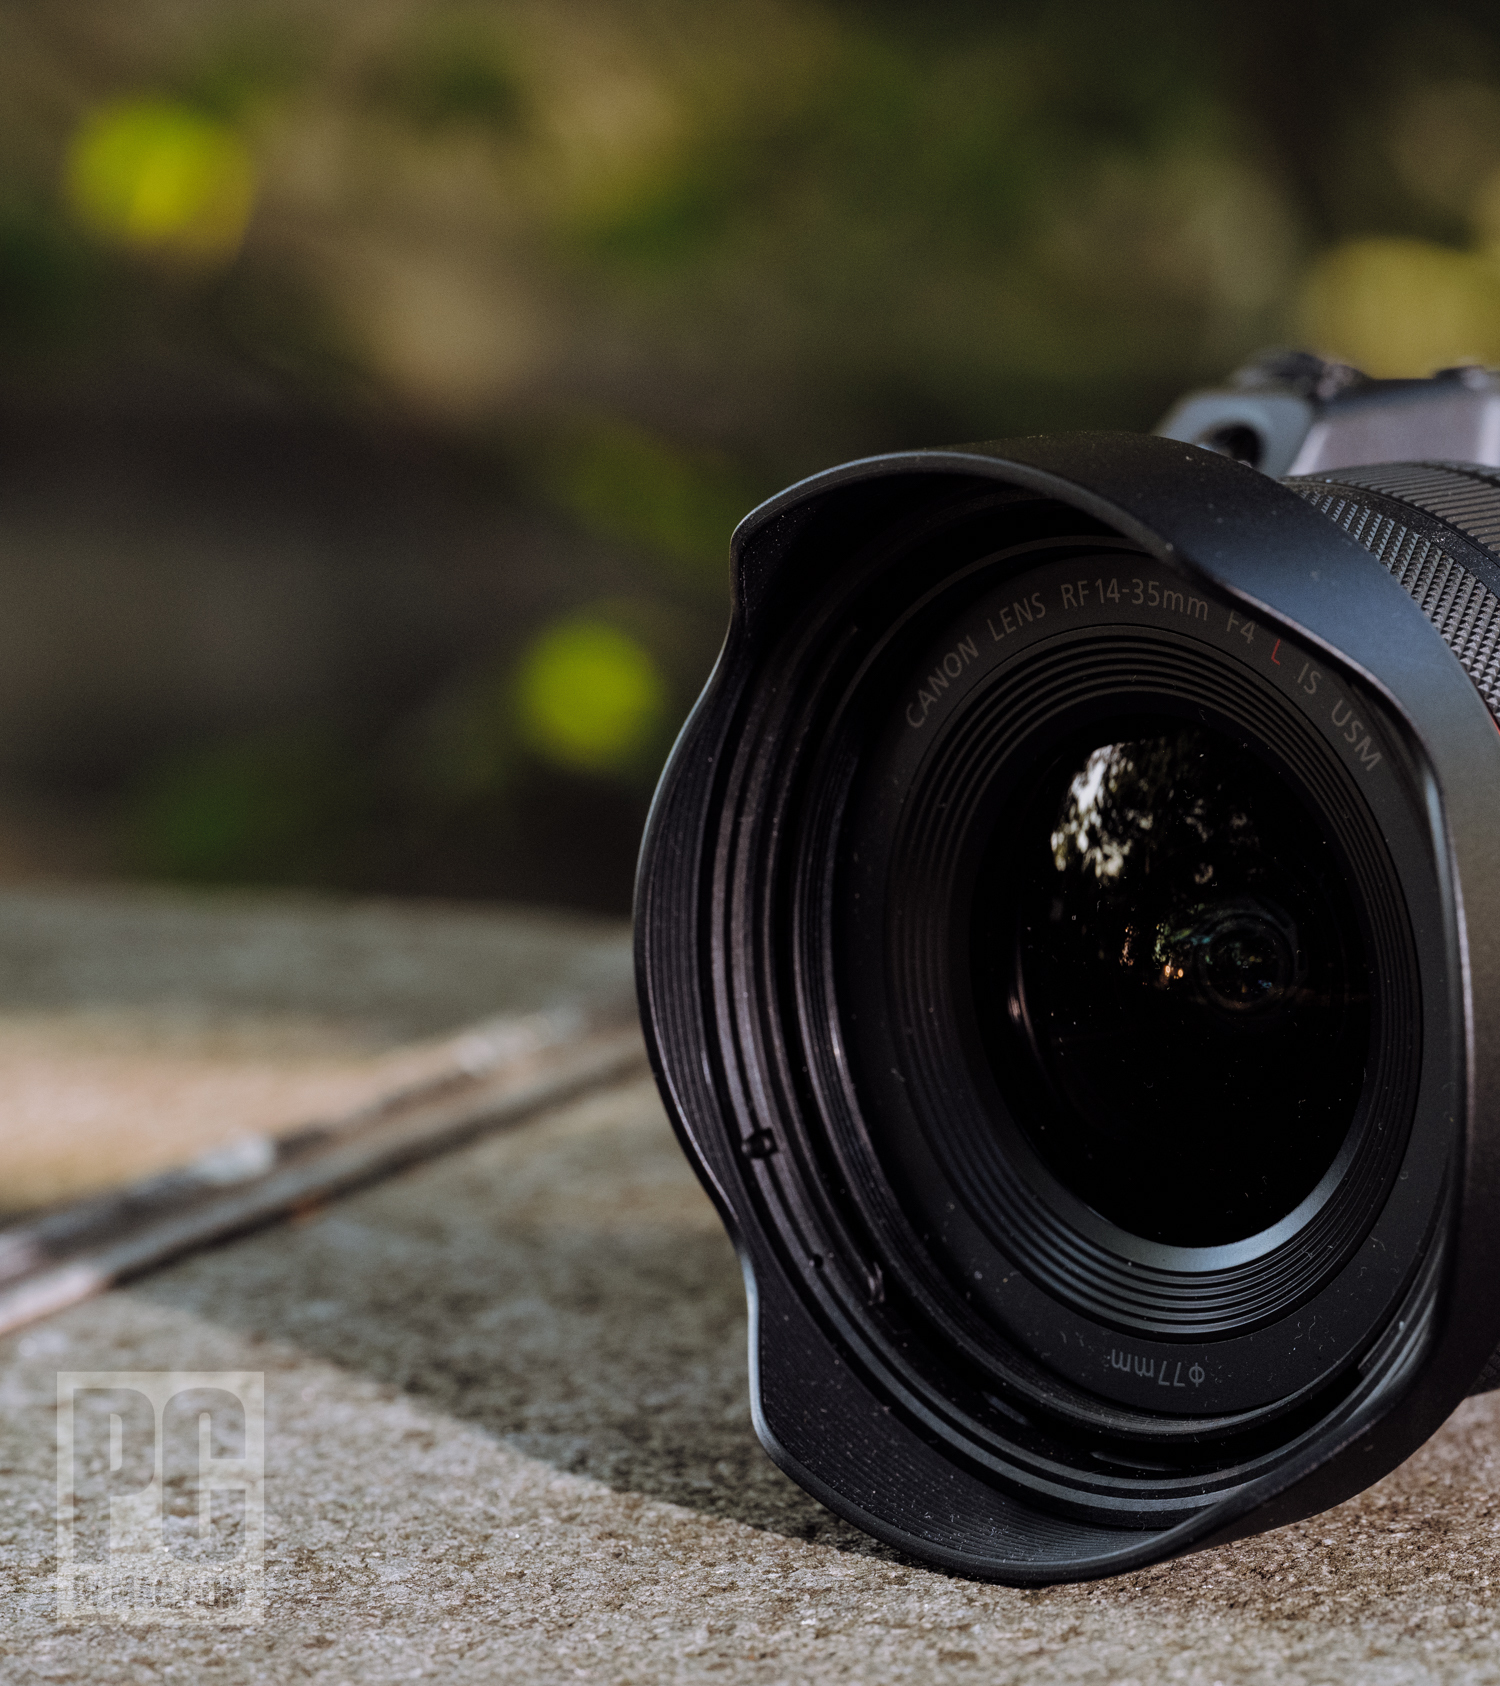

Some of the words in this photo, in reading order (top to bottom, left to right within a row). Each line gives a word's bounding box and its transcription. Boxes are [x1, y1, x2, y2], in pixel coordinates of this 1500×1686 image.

[907, 637, 979, 727] CANON
[988, 593, 1048, 642] LENS
[1227, 611, 1256, 644] F4
[1271, 639, 1281, 665] L
[1297, 663, 1322, 696] IS
[1331, 700, 1384, 772] USM
